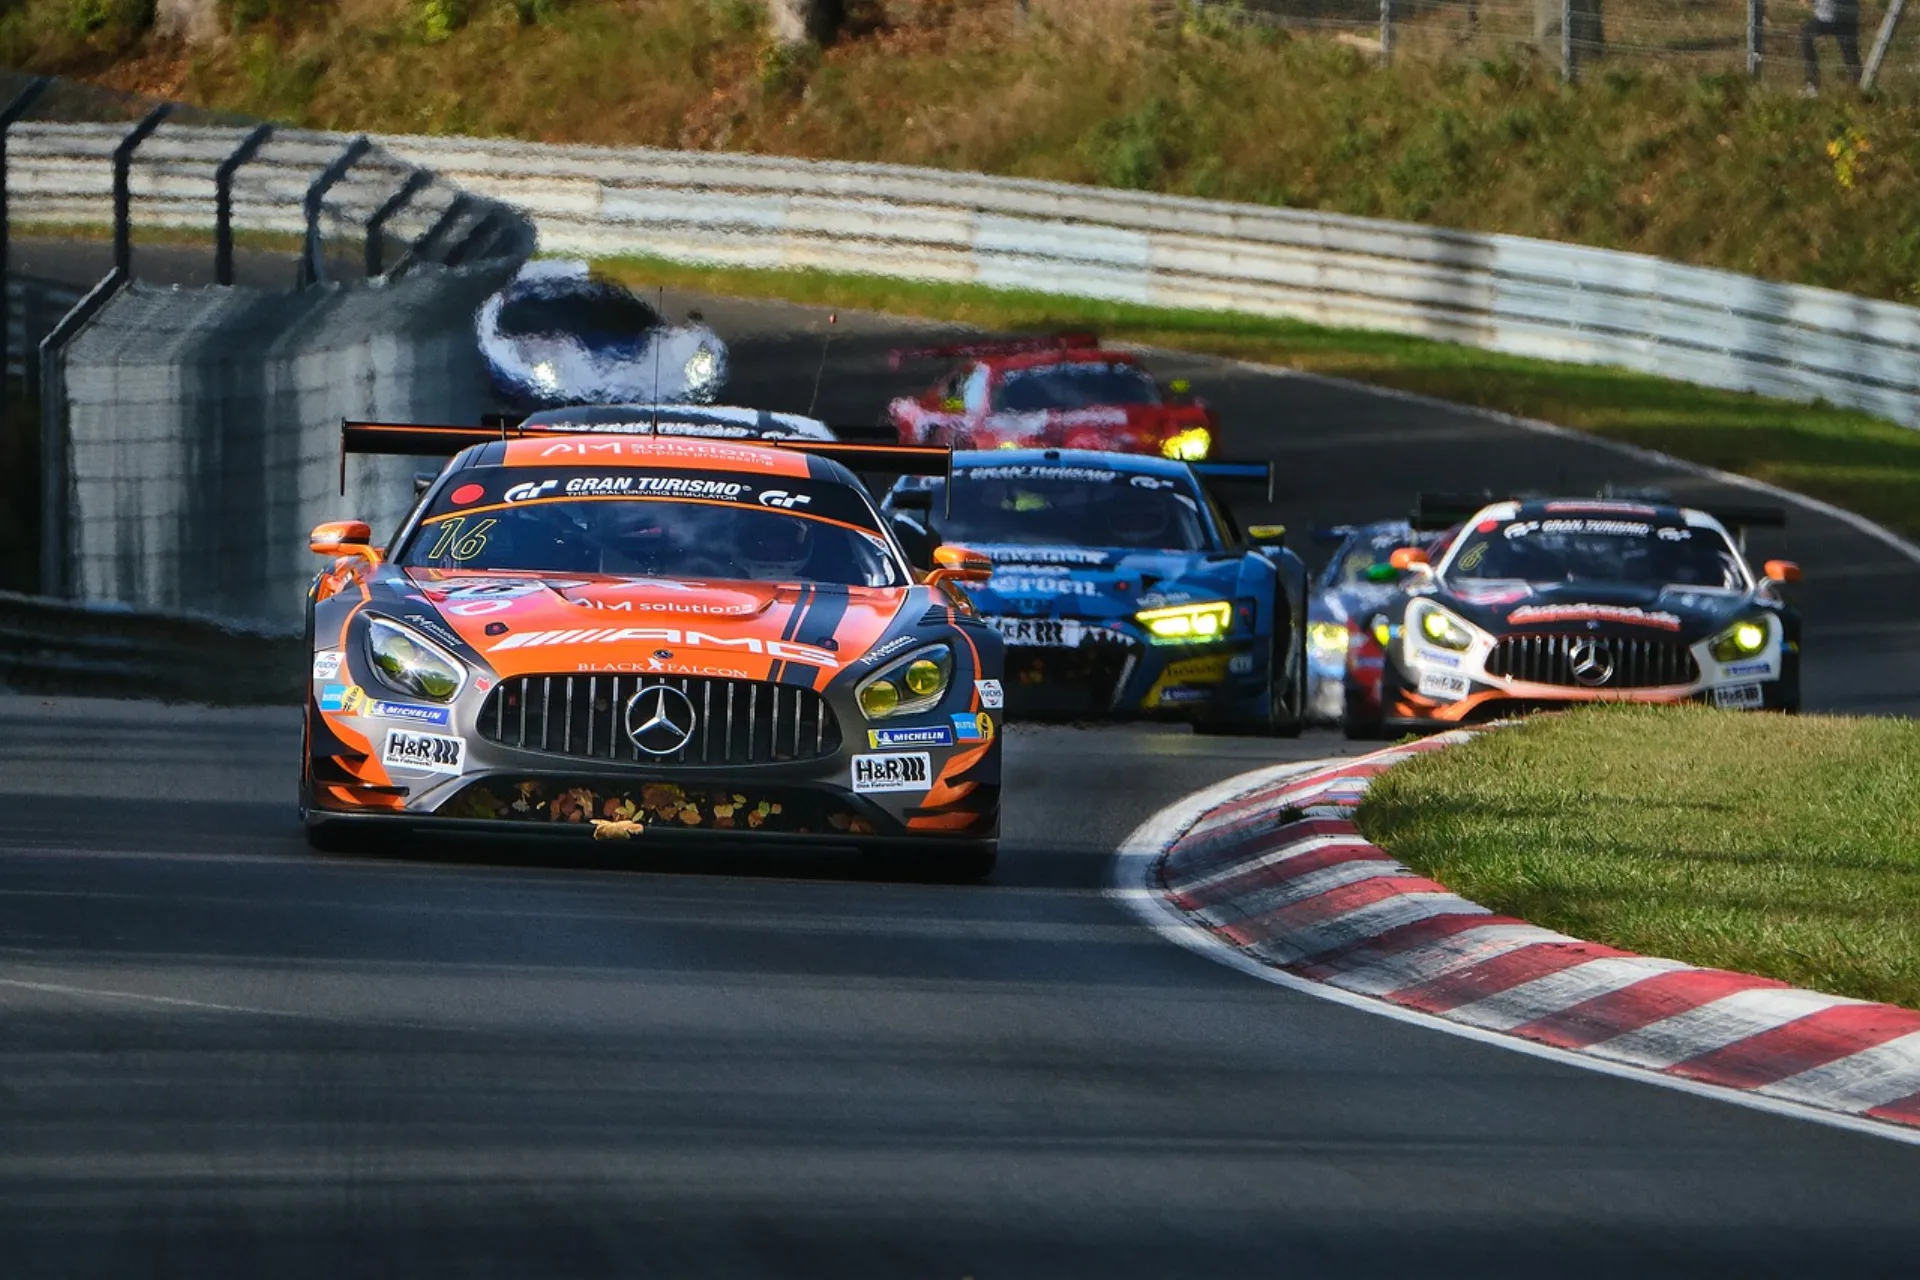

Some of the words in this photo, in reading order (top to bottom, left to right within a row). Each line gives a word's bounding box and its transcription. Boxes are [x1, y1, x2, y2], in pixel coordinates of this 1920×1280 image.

[565, 477, 632, 492] GRAN
[638, 477, 742, 495] TURISMO
[671, 490, 738, 501] SIMULATOR
[428, 517, 497, 560] 16
[1458, 541, 1489, 571] 6
[639, 601, 754, 615] solutions
[598, 626, 840, 668] AMG
[577, 661, 644, 673] BLACK
[667, 663, 749, 679] FALCON
[386, 705, 442, 720] MICHELIN
[388, 733, 432, 758] H&R
[893, 731, 945, 742] MICHELIN
[855, 758, 900, 780] H&R
